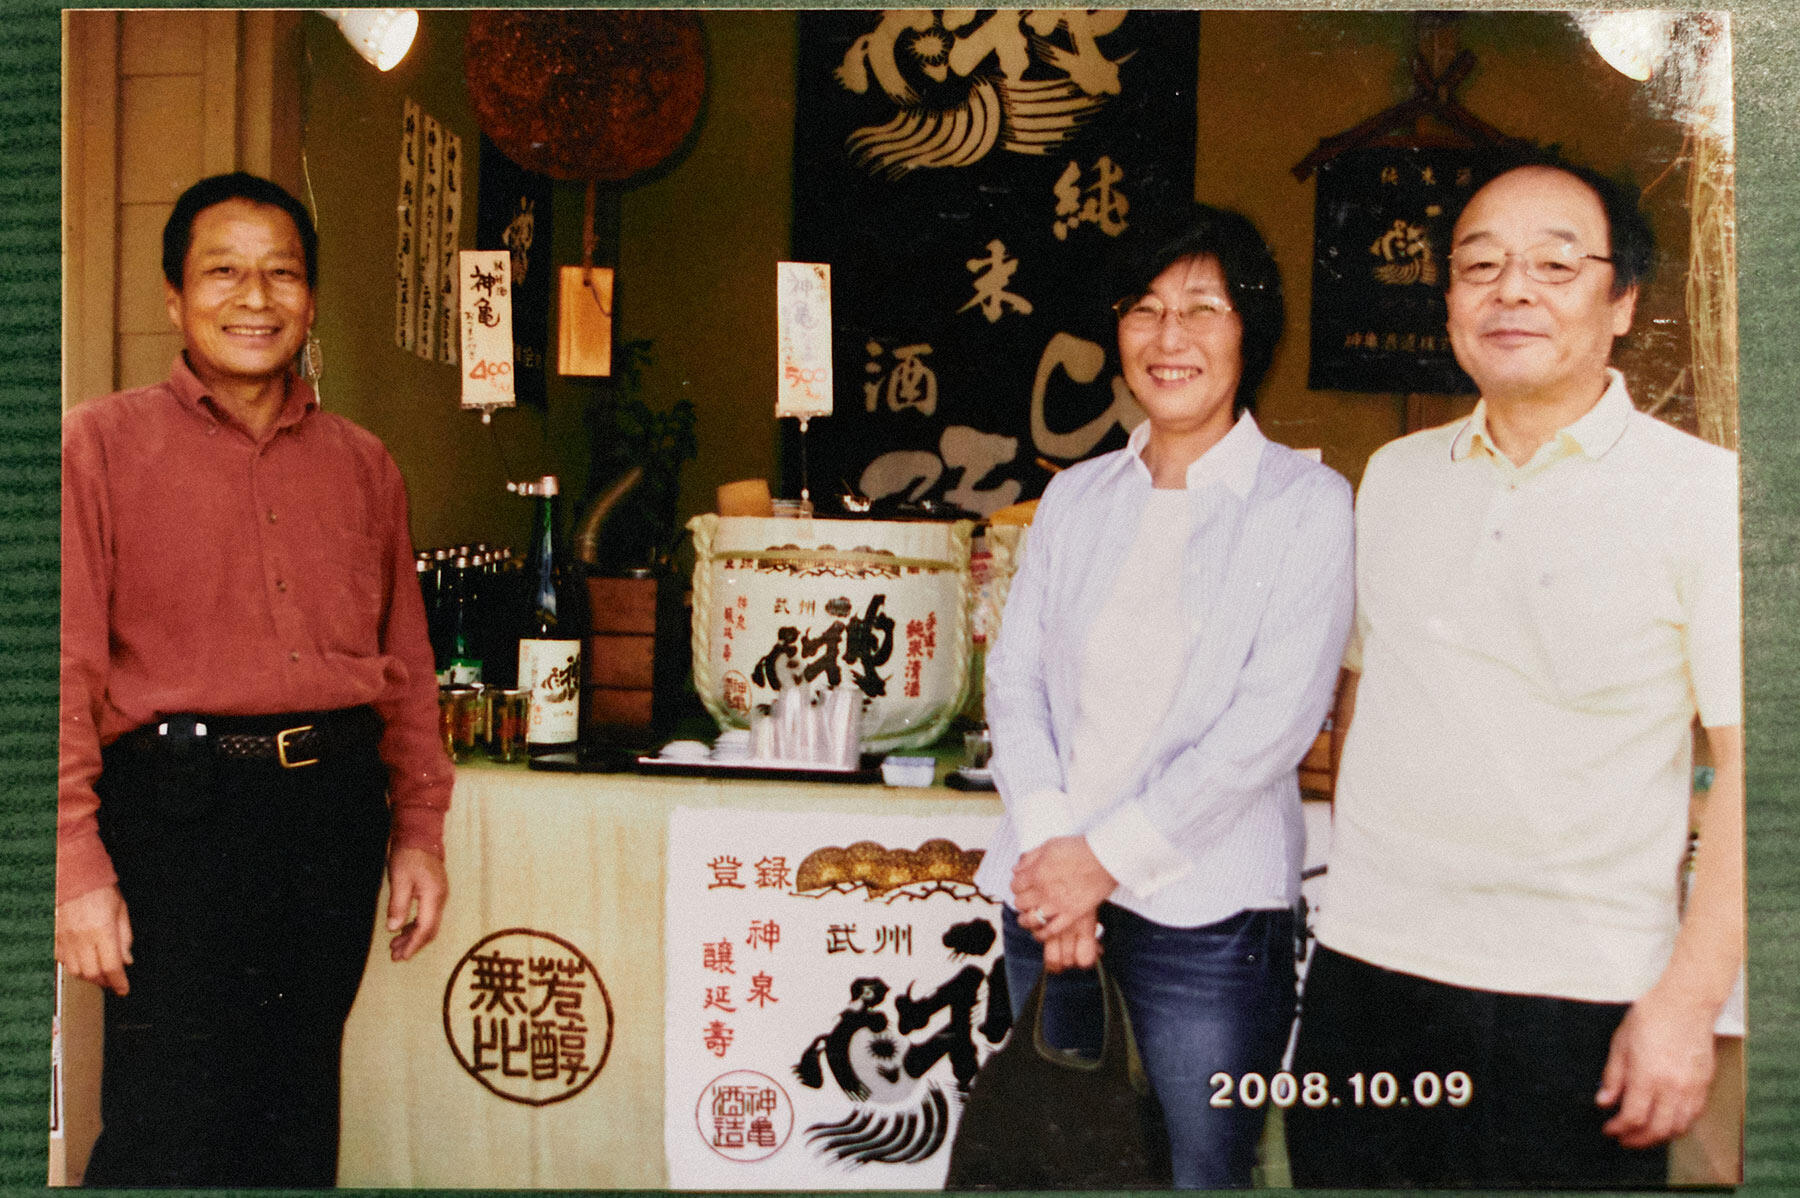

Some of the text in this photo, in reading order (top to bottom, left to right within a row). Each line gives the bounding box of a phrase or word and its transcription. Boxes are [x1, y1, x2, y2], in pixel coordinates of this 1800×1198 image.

[469, 264, 501, 329] 神亀
[469, 359, 512, 381] 400
[785, 366, 827, 388] 500
[826, 923, 913, 956] 武州
[745, 919, 781, 1009] 神泉
